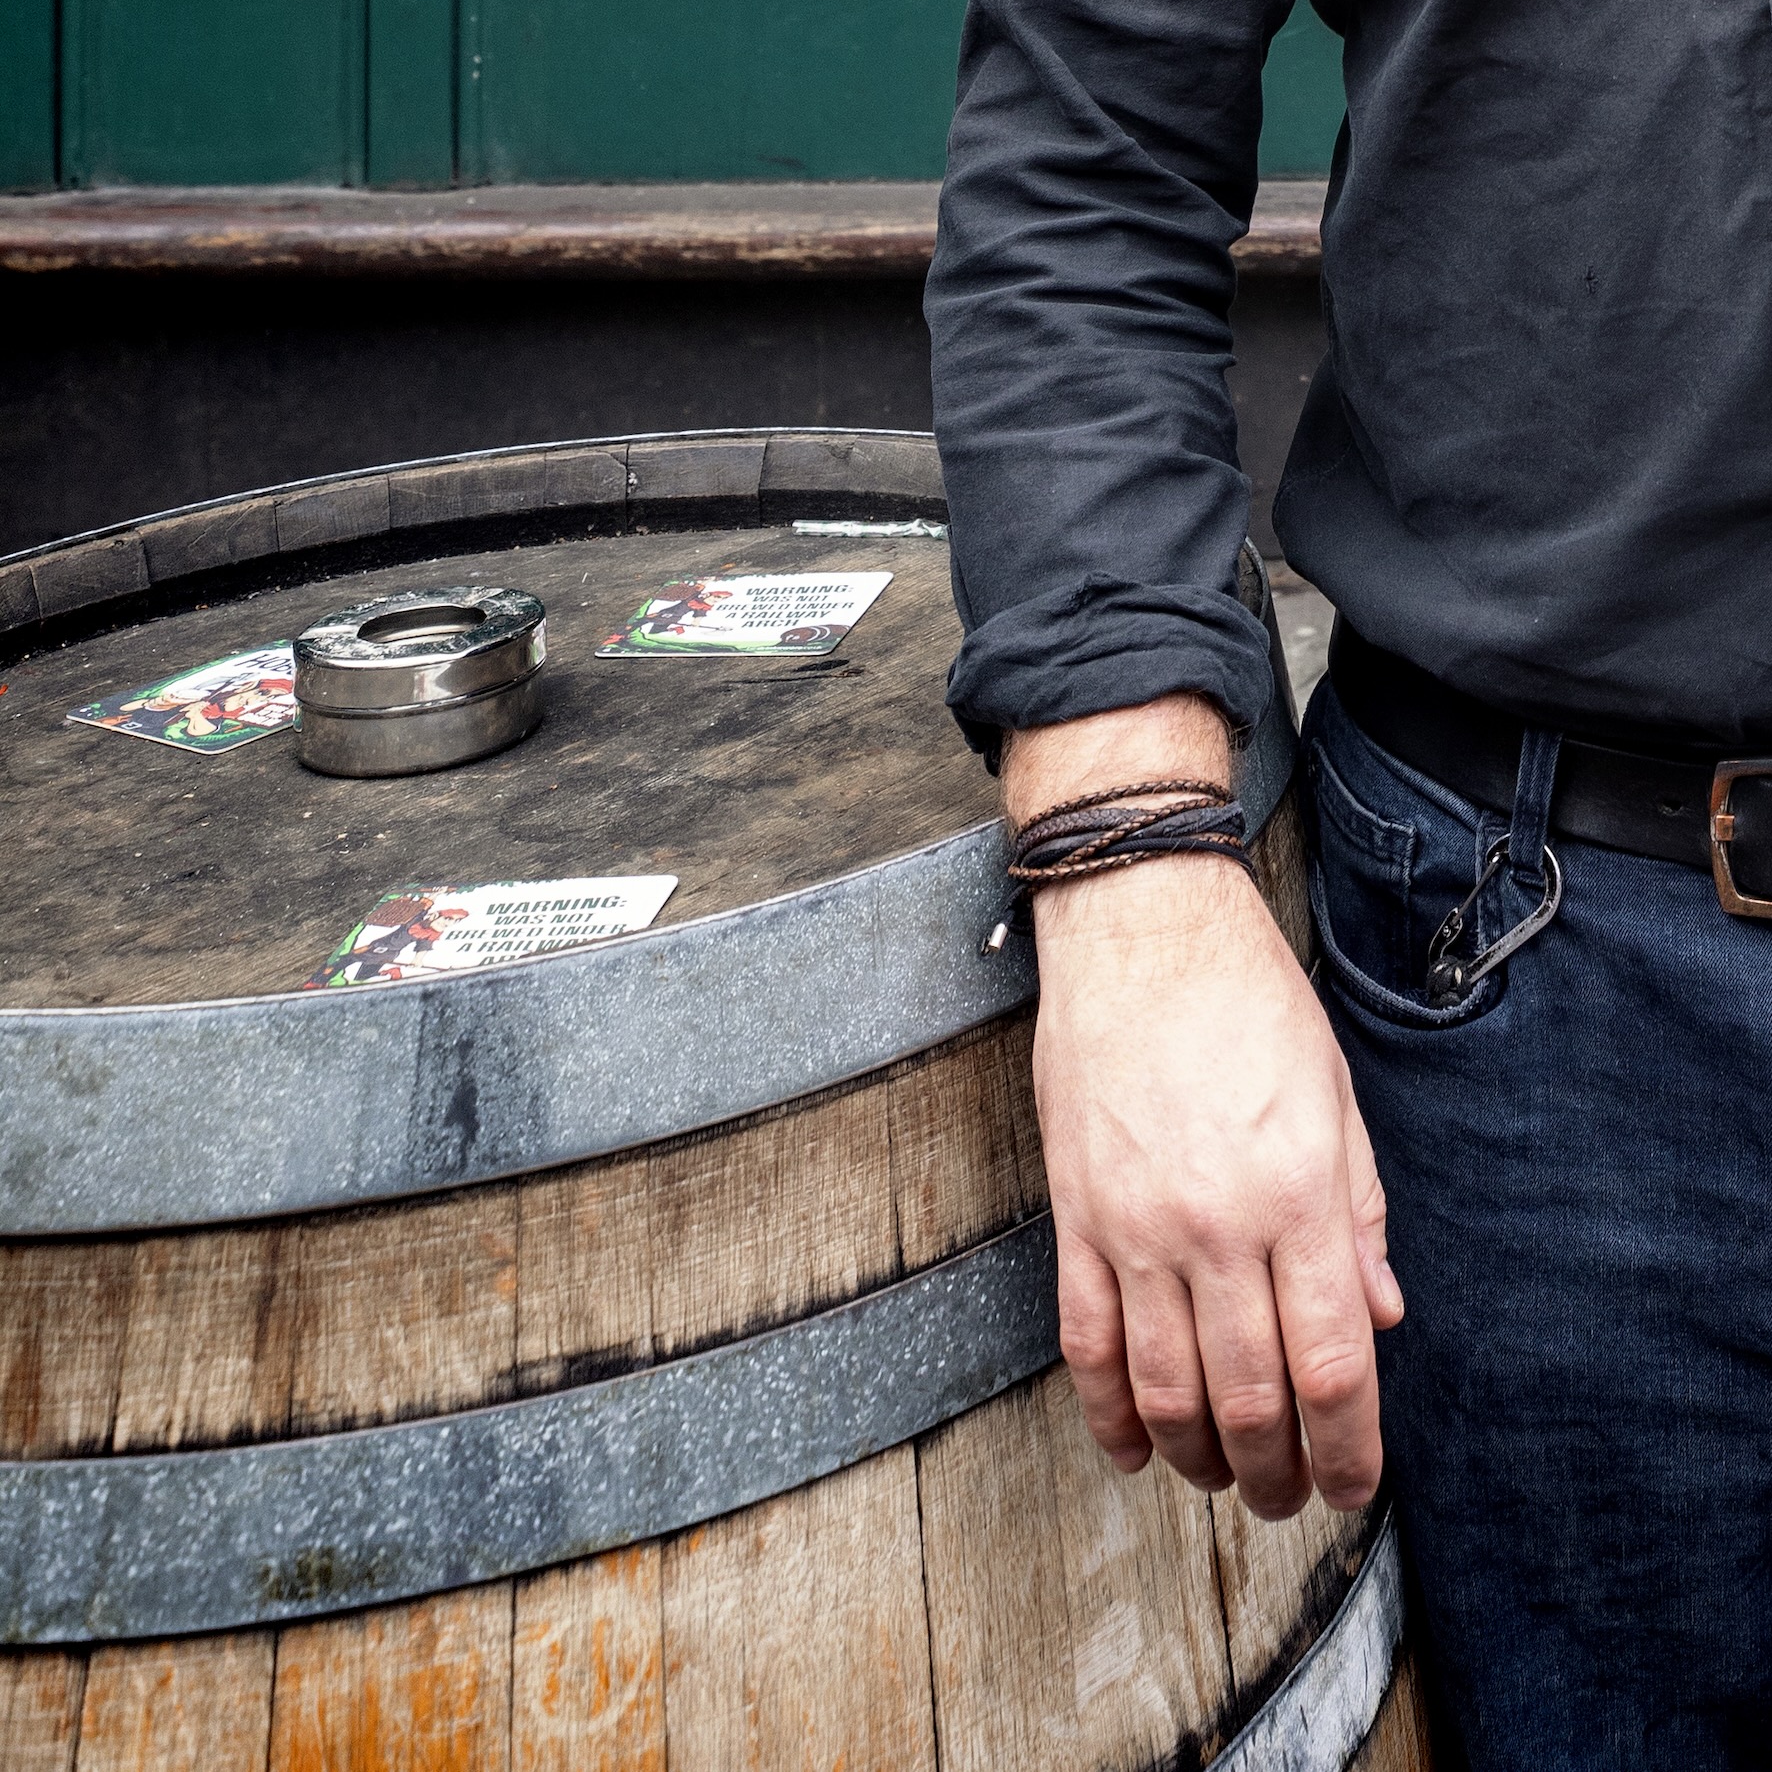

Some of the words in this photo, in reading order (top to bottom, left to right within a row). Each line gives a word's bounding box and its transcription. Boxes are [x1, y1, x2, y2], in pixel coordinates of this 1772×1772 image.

[746, 585, 855, 596] WARNING:
[752, 595, 792, 603] WAS
[796, 595, 829, 603] NOT
[794, 602, 855, 610] UNDER
[741, 611, 832, 619] RAILWAY
[741, 619, 800, 628] ARCH
[486, 895, 628, 916] WARNING:
[494, 914, 547, 926] WAS
[549, 913, 594, 925] NOT
[445, 927, 545, 941] BREWED
[547, 923, 628, 937] UNDER
[456, 942, 473, 953] A
